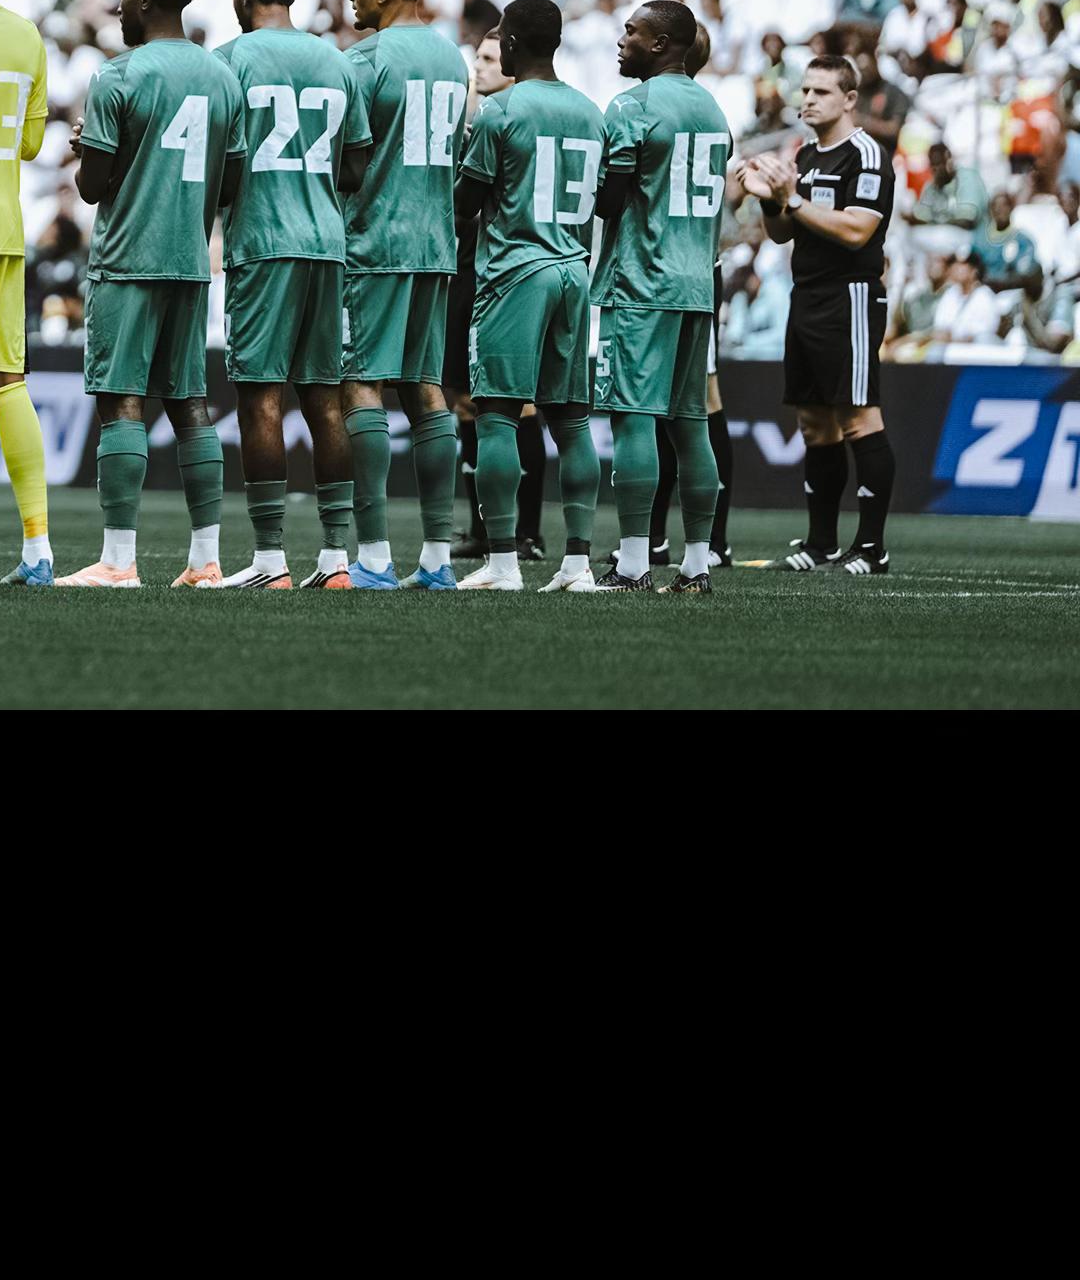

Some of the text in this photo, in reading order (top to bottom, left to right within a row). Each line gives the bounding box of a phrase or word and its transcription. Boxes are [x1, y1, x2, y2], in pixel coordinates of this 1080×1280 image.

[160, 95, 208, 182] 4
[246, 84, 347, 175] 22
[403, 79, 467, 166] 18
[533, 136, 602, 225] 13
[668, 132, 728, 217] 15
[596, 340, 611, 377] 5
[954, 397, 1041, 487] Z
